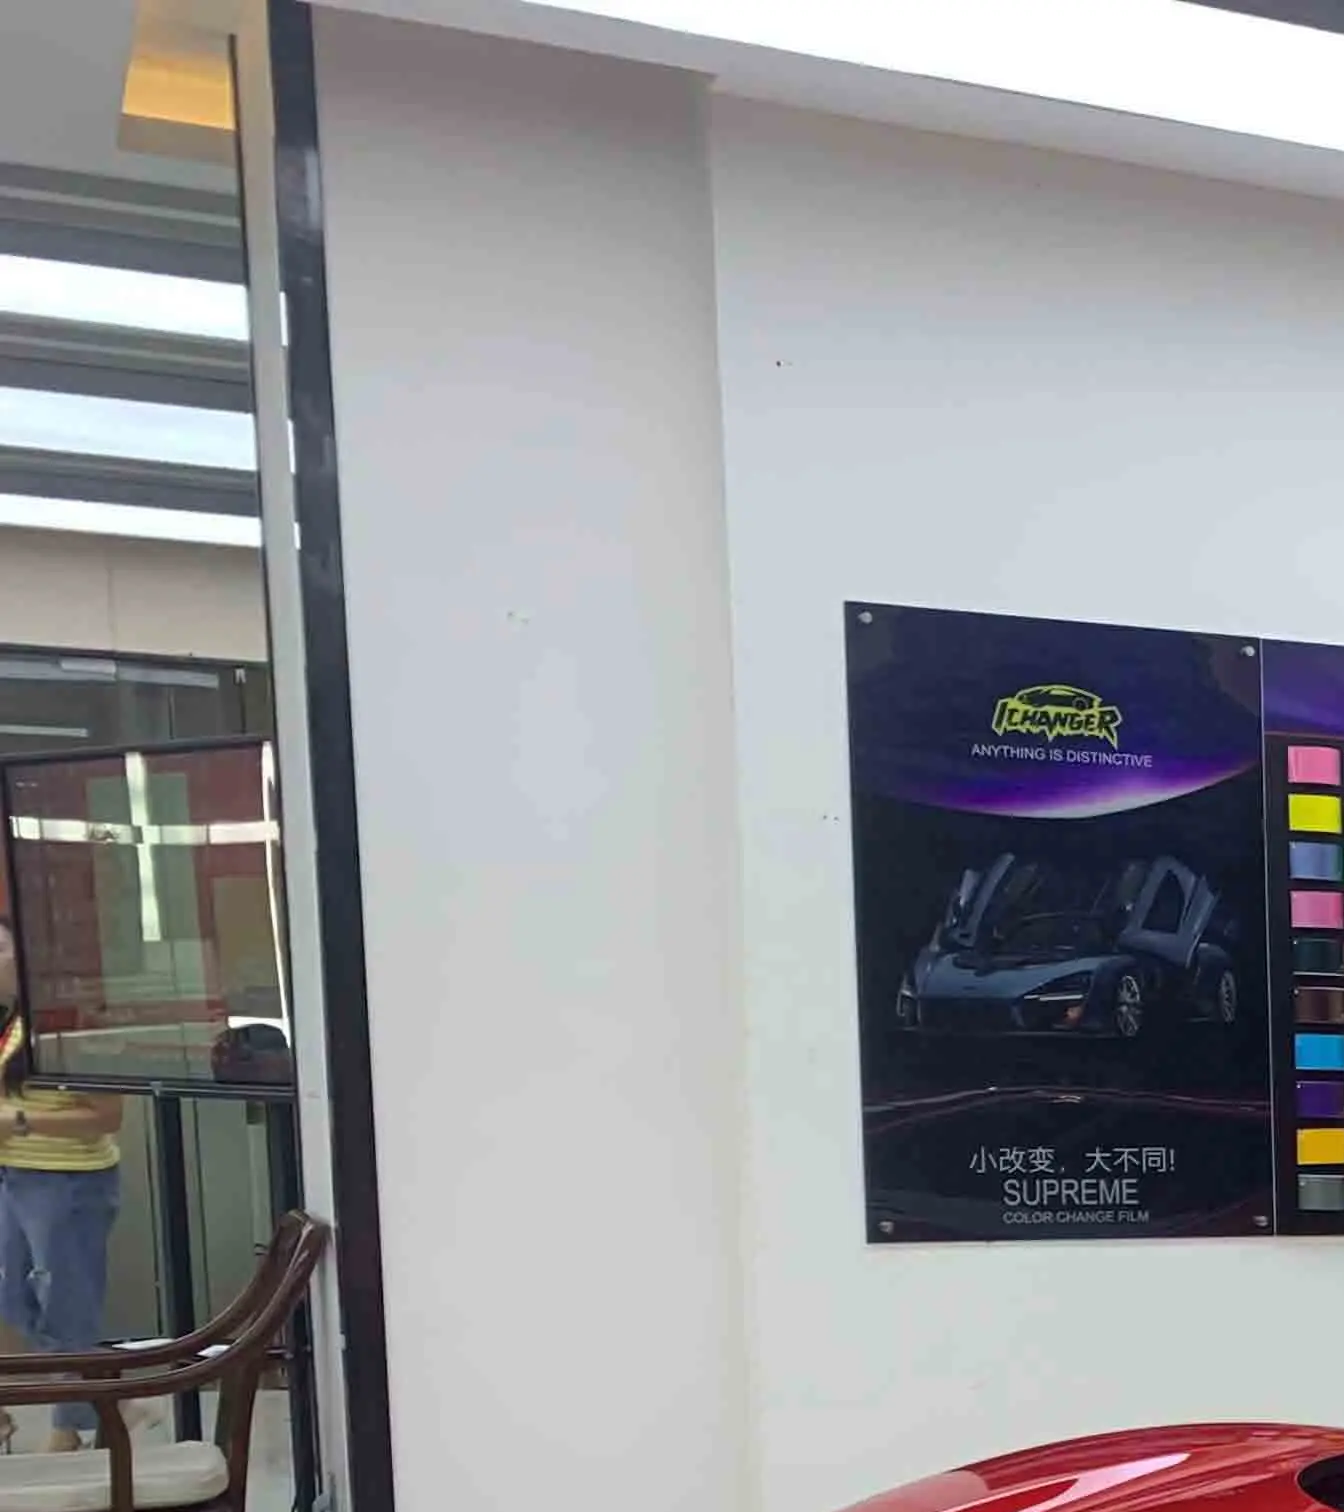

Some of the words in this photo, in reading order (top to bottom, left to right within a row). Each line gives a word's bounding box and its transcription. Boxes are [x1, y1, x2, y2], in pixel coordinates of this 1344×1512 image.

[971, 744, 1046, 761] ANYTHING
[1049, 750, 1064, 762] IS
[1066, 750, 1153, 768] DISTINCTIVE
[1002, 1178, 1141, 1206] SUPREME
[1002, 1211, 1053, 1225] COLOR
[1056, 1210, 1115, 1224] CHANGE
[1117, 1210, 1150, 1223] FILM
